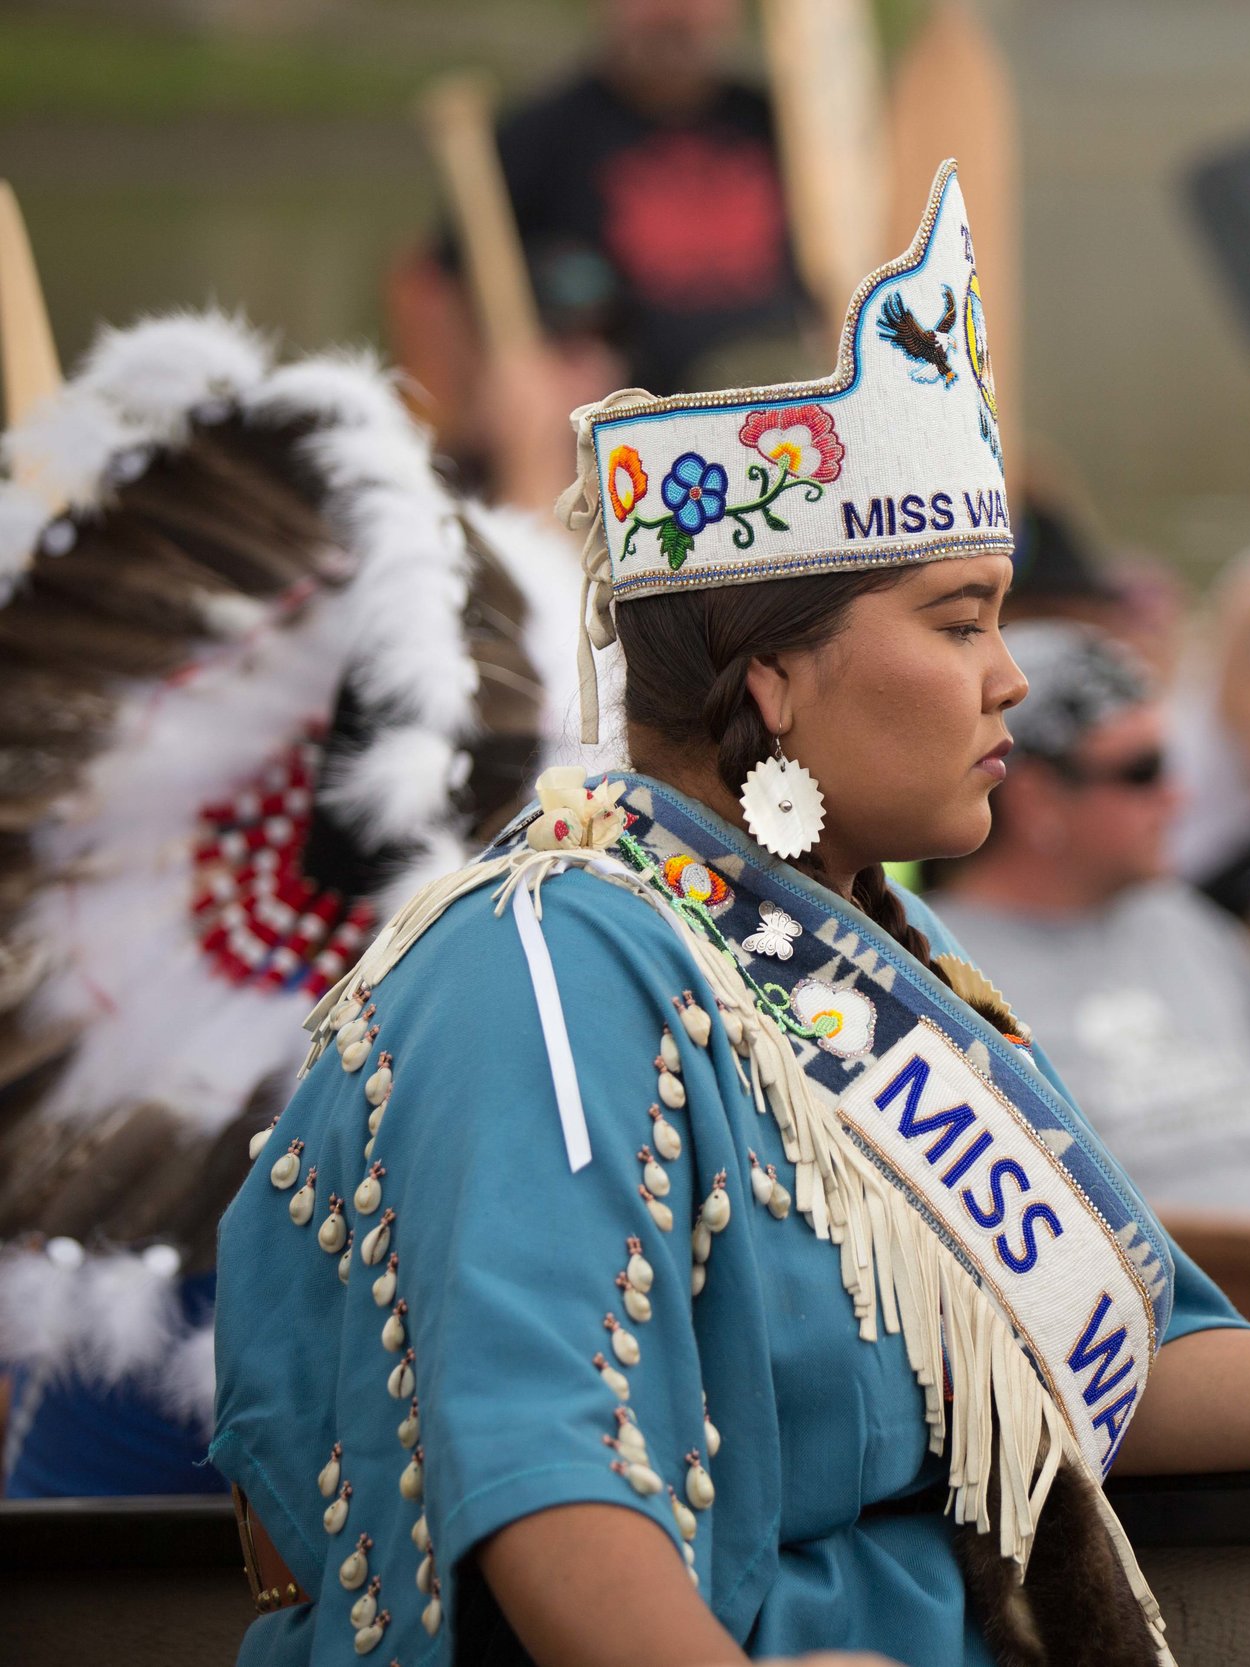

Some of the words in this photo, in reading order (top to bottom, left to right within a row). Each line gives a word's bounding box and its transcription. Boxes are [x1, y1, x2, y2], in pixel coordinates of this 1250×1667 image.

[843, 492, 955, 539] MISS
[874, 1055, 1063, 1274] MISS
[1066, 1292, 1138, 1477] WA
